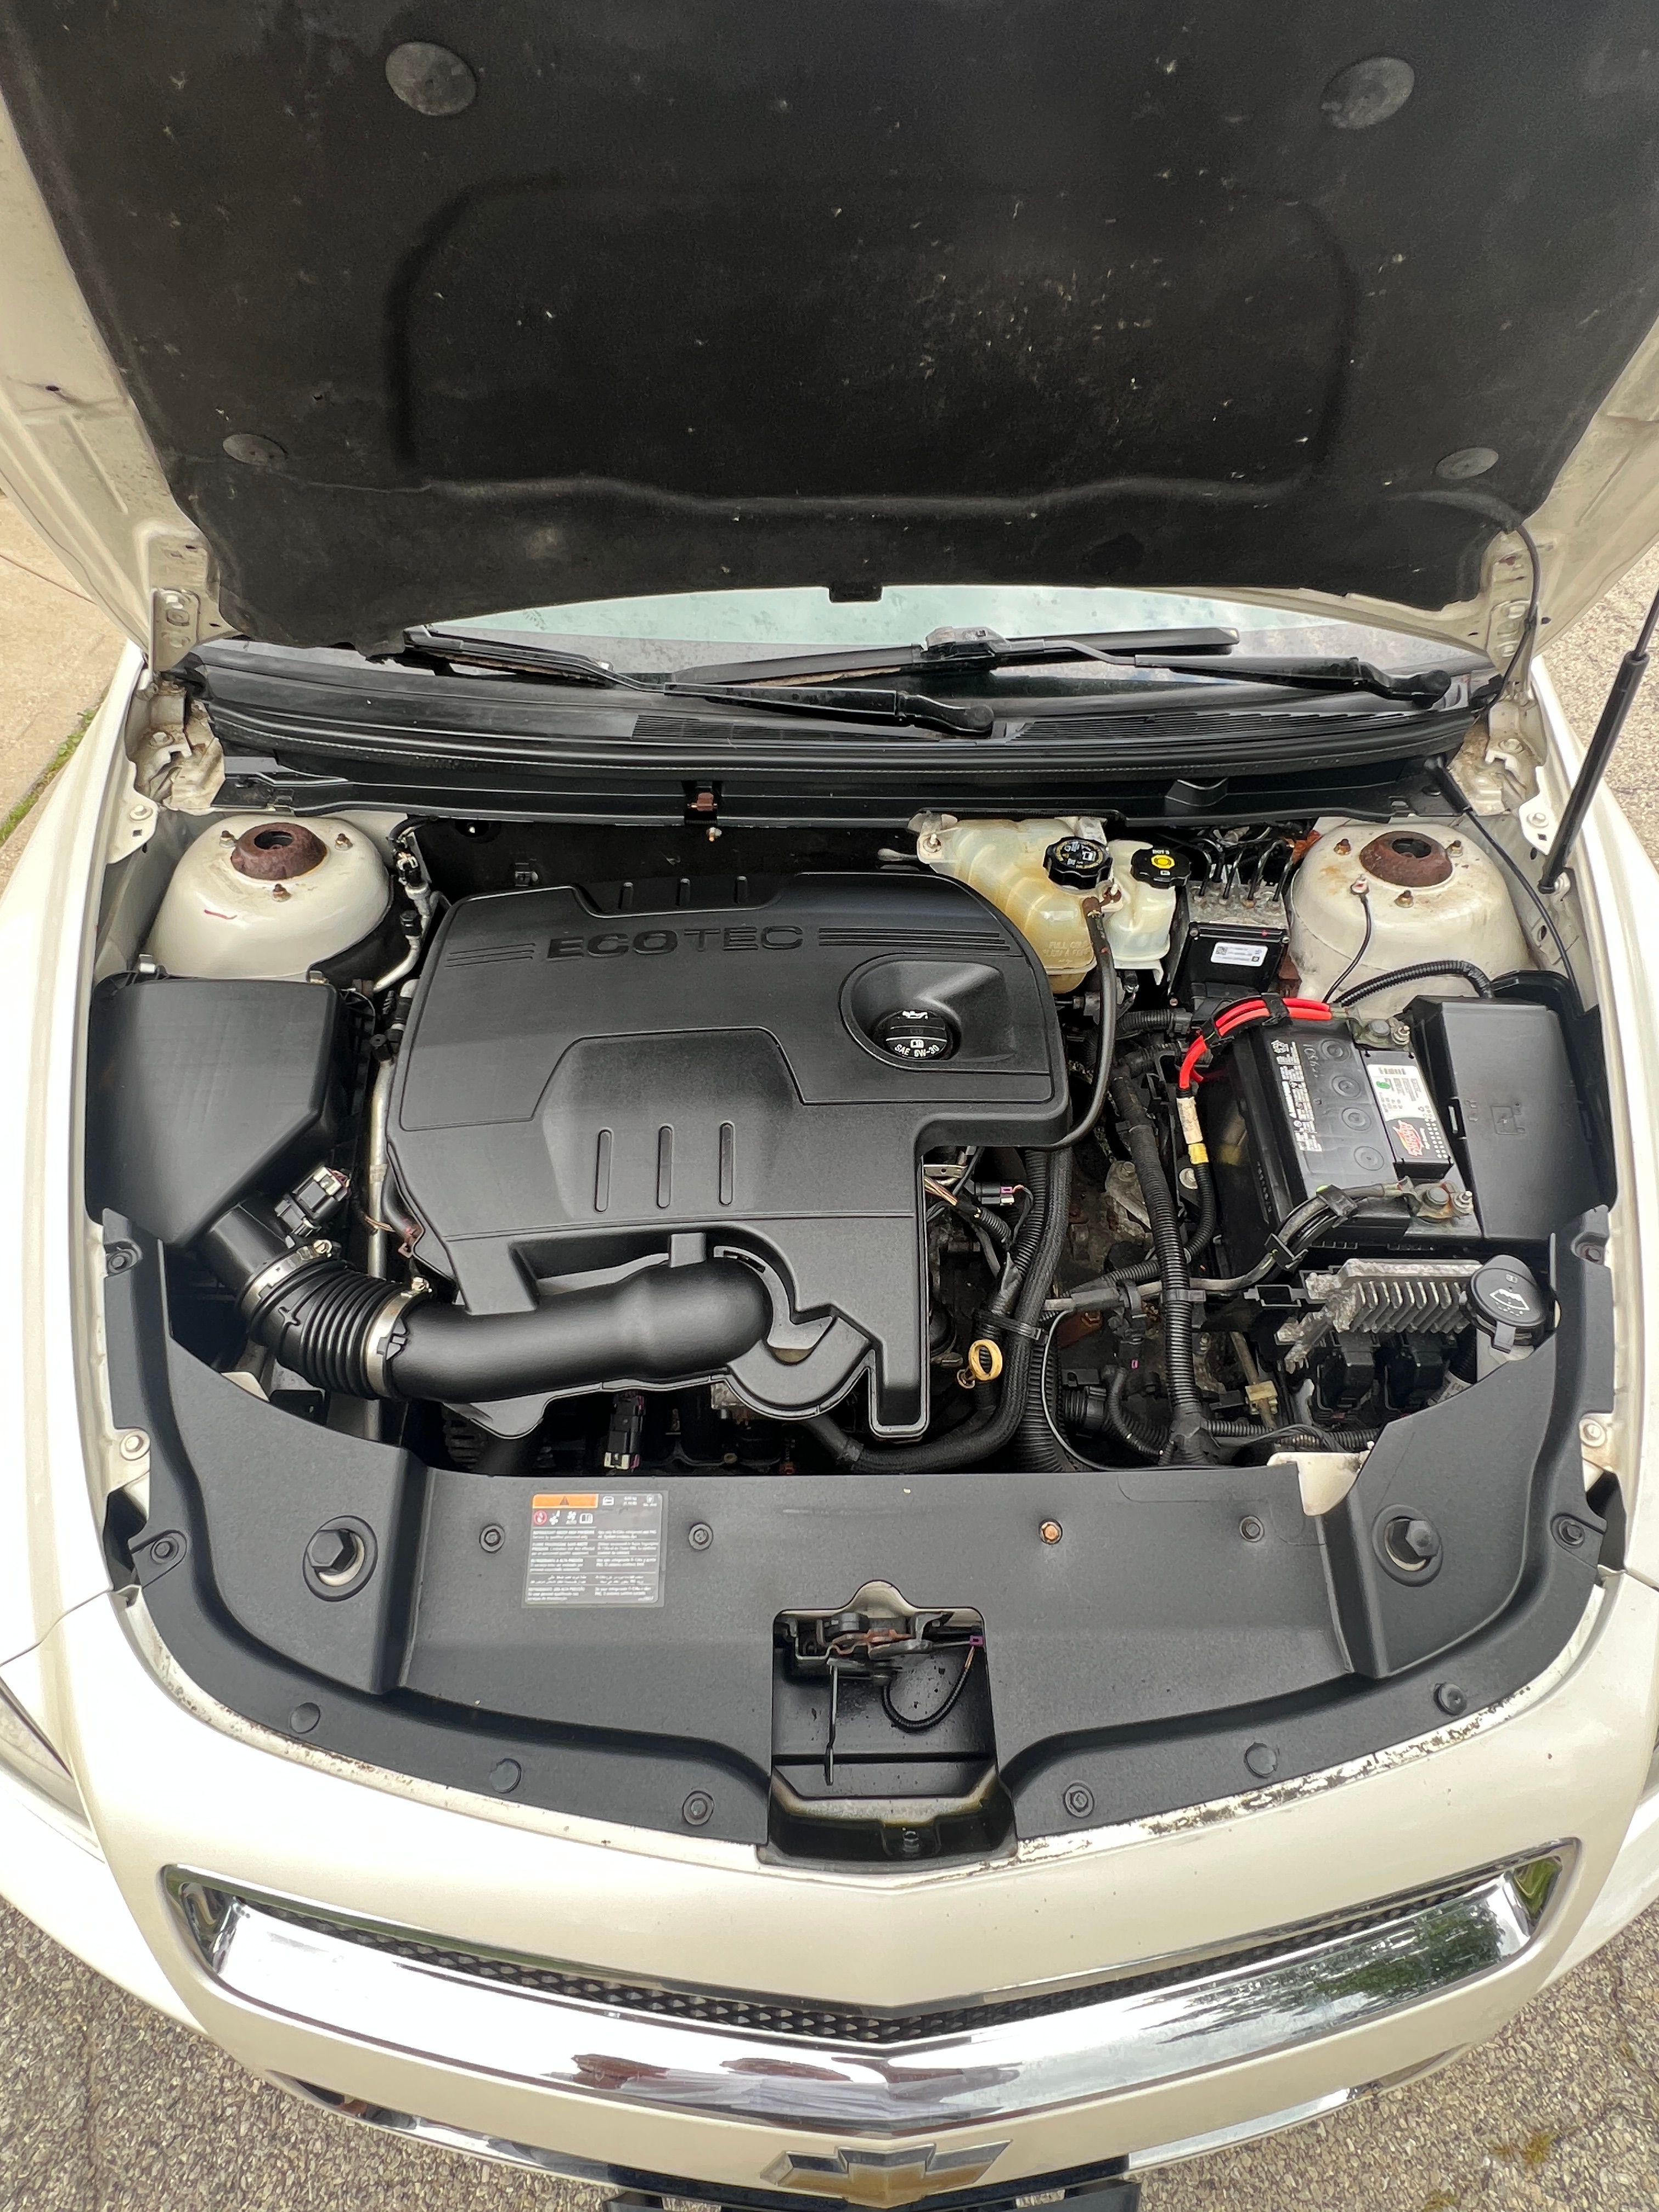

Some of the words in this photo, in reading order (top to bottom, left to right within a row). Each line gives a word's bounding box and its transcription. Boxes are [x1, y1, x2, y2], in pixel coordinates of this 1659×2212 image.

[546, 924, 803, 961] ECOTEC
[894, 1043, 911, 1056] SAE
[913, 1044, 940, 1057] 5W-30
